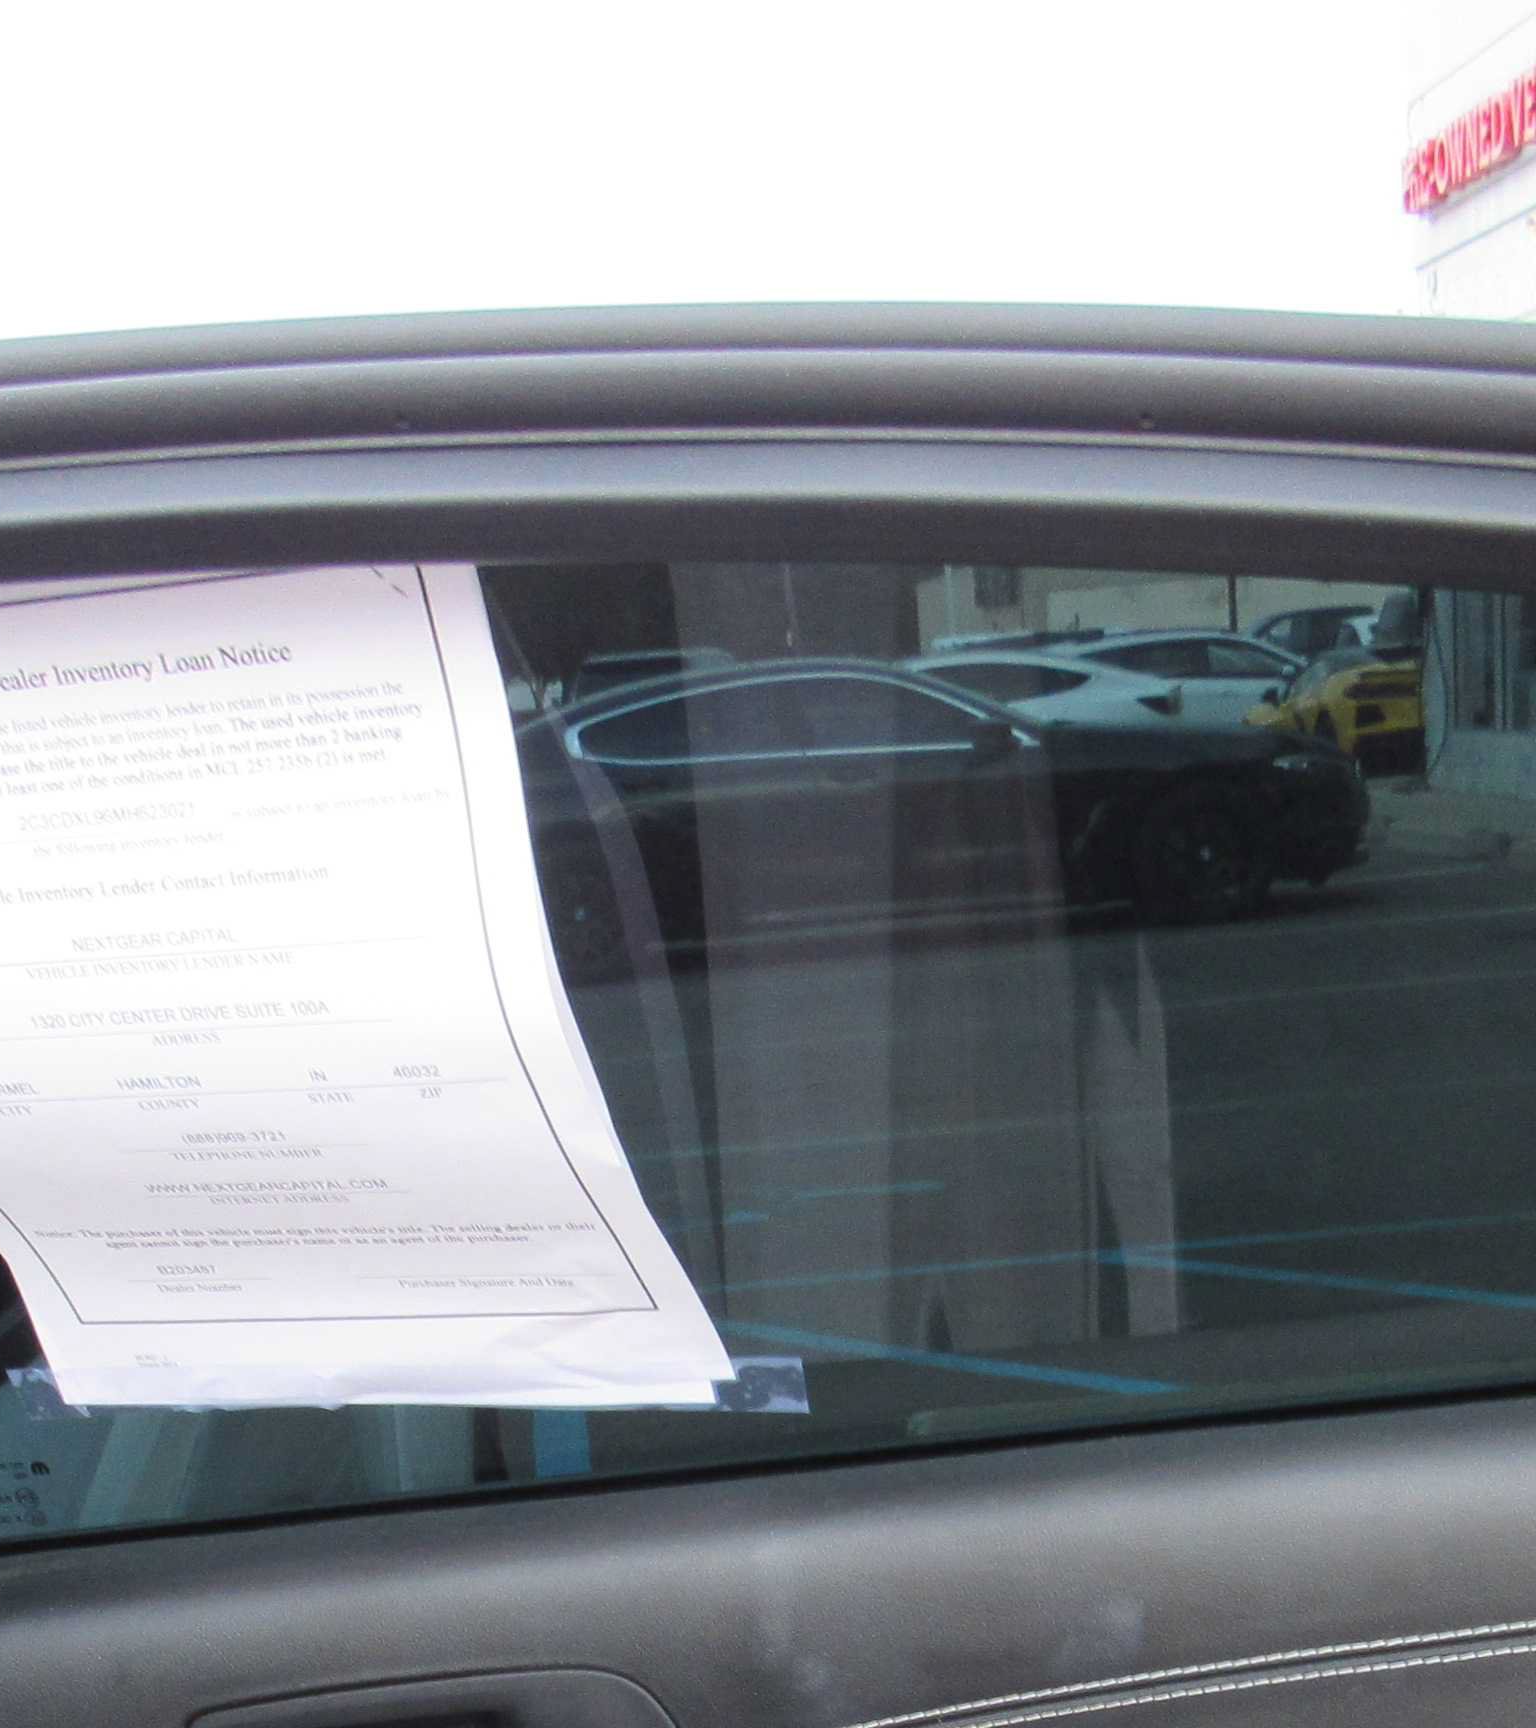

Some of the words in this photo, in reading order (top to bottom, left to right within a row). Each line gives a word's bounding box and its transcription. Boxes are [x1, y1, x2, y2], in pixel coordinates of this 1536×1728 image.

[52, 659, 153, 687] Inventory
[158, 650, 216, 675] Loan
[218, 641, 293, 668] Notice
[18, 882, 95, 906] Inventory
[98, 879, 156, 899] Lender
[161, 872, 223, 893] Contact
[229, 865, 329, 889] Information
[71, 932, 161, 954] NEXTGEAR
[165, 927, 238, 947] CAPITAL
[25, 964, 89, 982] VEHICLE
[94, 958, 178, 978] INVENTORY
[183, 954, 244, 972] LENDER
[249, 950, 296, 968] NAME
[30, 1012, 67, 1030] 1320
[68, 1010, 105, 1028] CITY
[109, 1007, 178, 1026] CENTER
[180, 1004, 232, 1022] DRIVE
[234, 1002, 286, 1020] SUITE
[290, 999, 330, 1017] 100A
[151, 1029, 222, 1047] ADDRESS
[116, 1073, 203, 1091] HAMILTON
[308, 1067, 328, 1083] IN
[137, 1096, 201, 1113] COUNTY
[305, 1090, 355, 1105] STATE
[418, 1085, 443, 1100] ZIP
